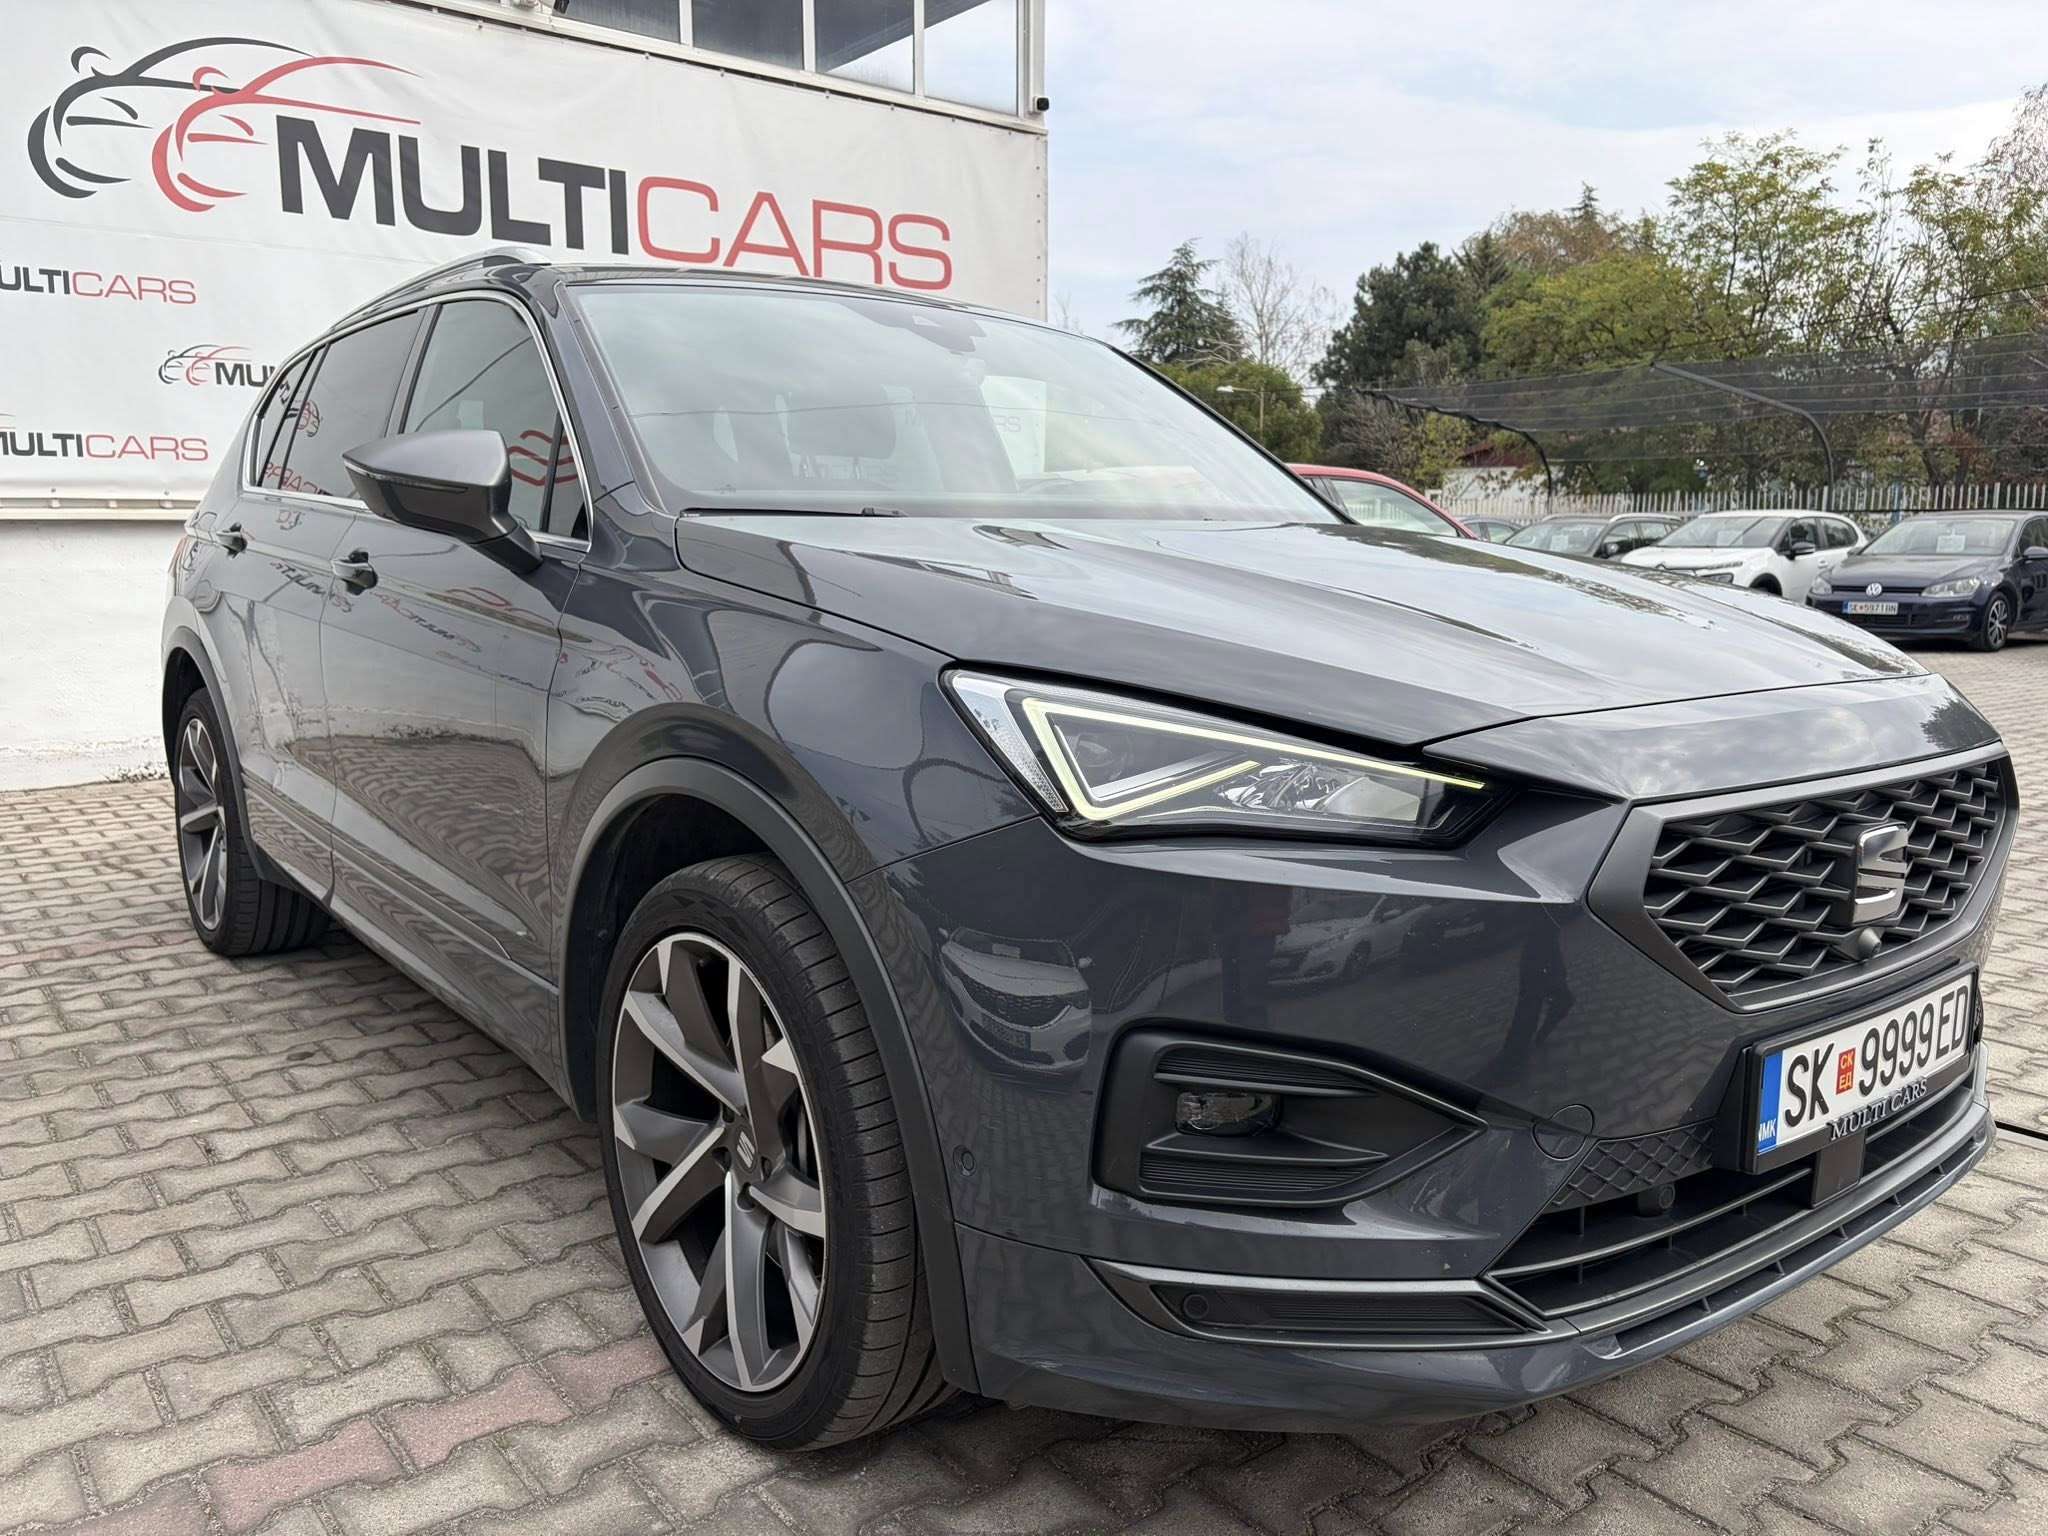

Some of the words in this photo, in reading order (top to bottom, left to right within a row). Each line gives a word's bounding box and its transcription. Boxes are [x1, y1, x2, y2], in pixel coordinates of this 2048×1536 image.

[276, 114, 952, 290] MULTICARS
[1785, 1042, 1835, 1127] SK
[1859, 985, 1969, 1096] 9999ED
[1829, 1099, 1890, 1141] MULTI
[1890, 1078, 1928, 1111] CARS
